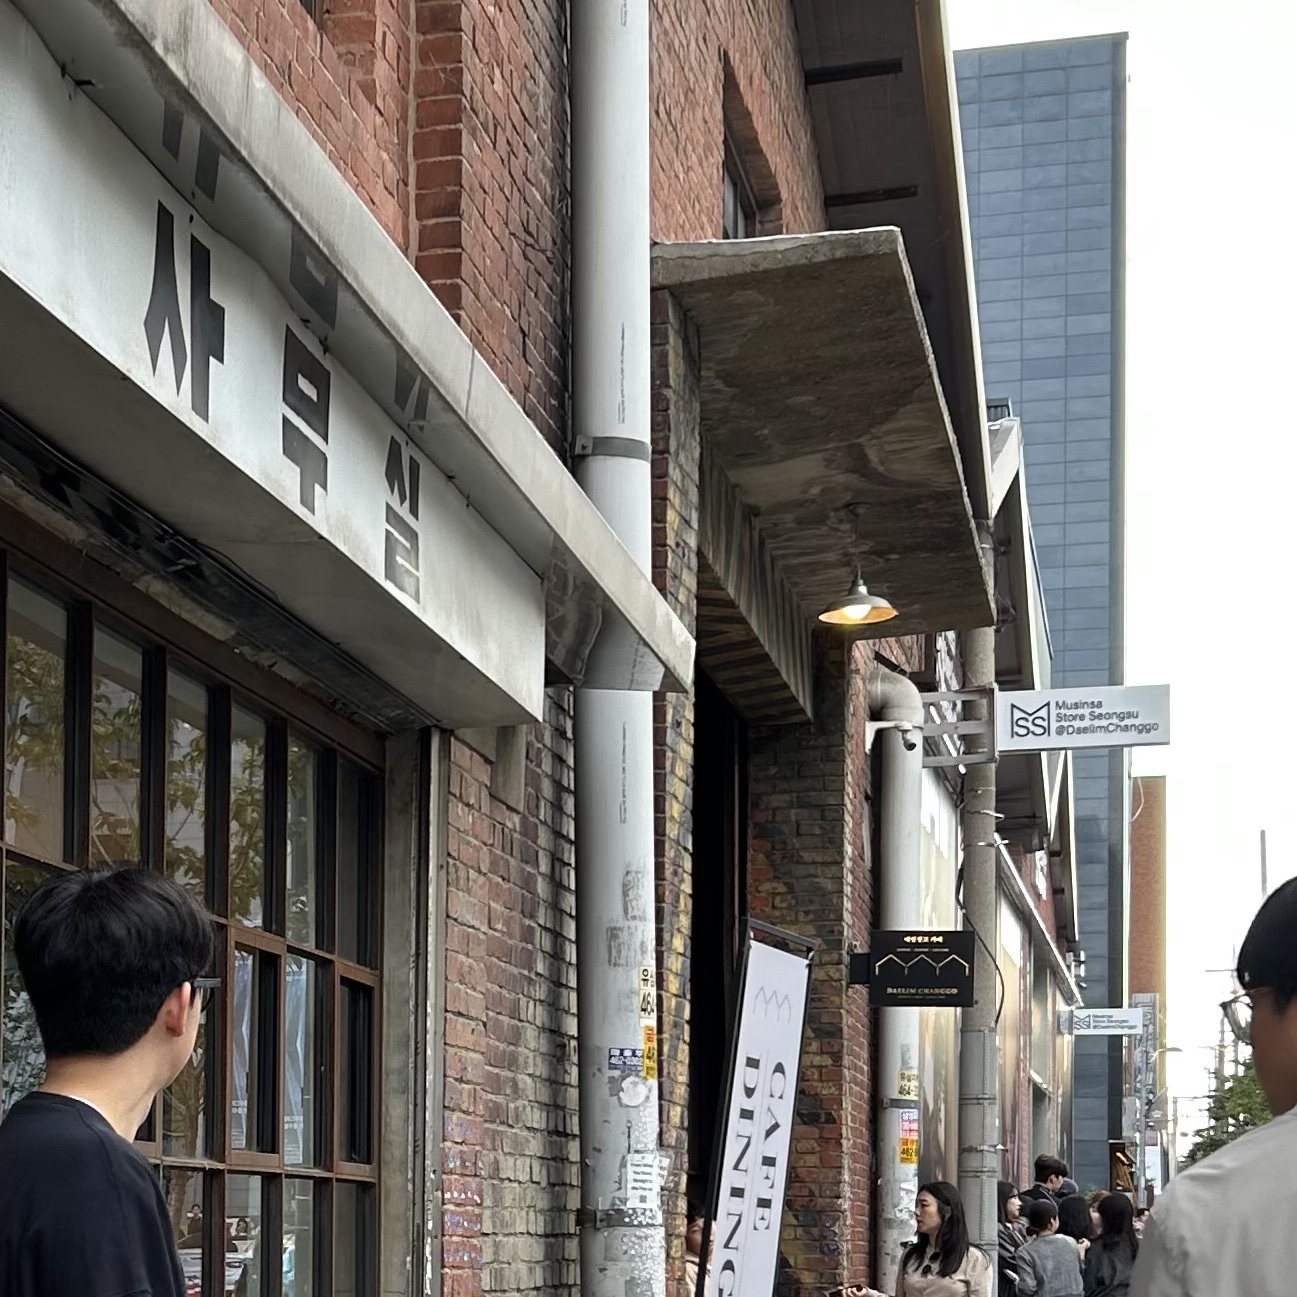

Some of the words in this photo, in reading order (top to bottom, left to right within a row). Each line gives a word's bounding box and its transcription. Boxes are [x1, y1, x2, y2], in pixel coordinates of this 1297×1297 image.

[1055, 700, 1103, 711] Musinsa
[1055, 713, 1086, 723] Store
[1088, 710, 1140, 723] Seongsu
[753, 1061, 787, 1231] CAFE
